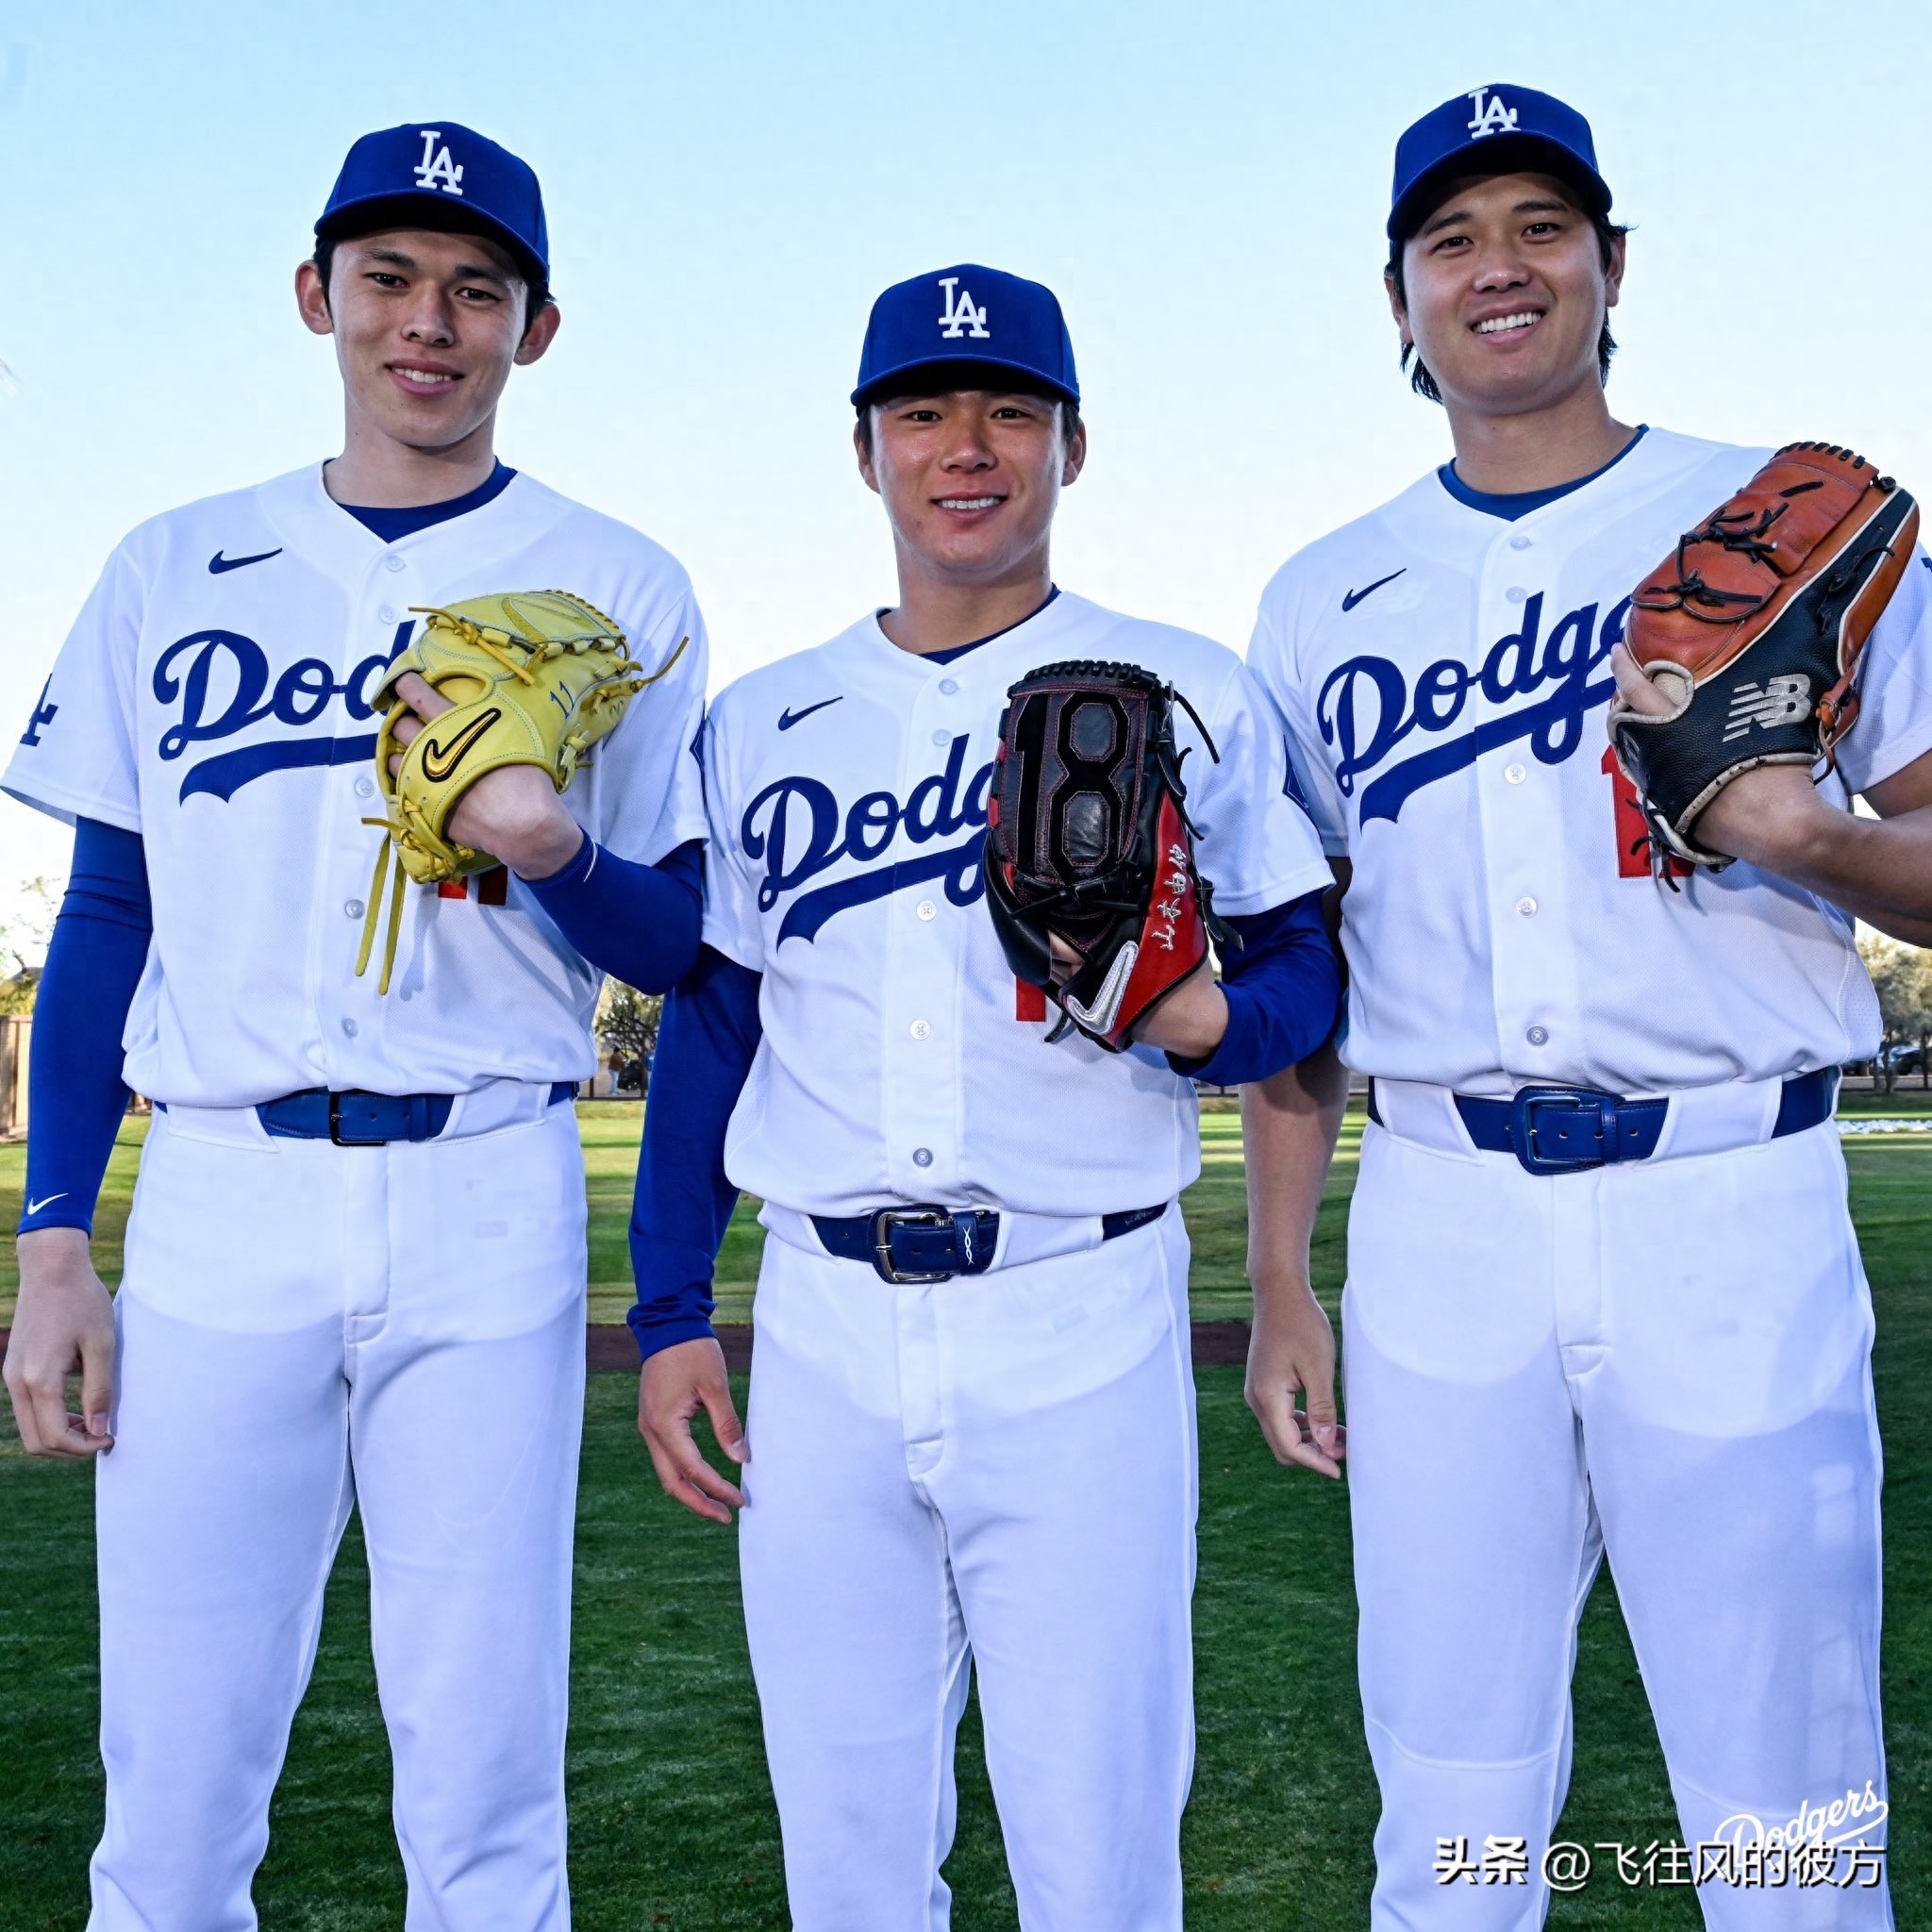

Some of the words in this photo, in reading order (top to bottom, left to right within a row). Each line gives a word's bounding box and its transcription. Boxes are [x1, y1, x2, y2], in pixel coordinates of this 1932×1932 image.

[1467, 87, 1522, 140] LA
[413, 130, 464, 196] LA
[938, 276, 991, 339] LA
[1014, 691, 1131, 885] 18
